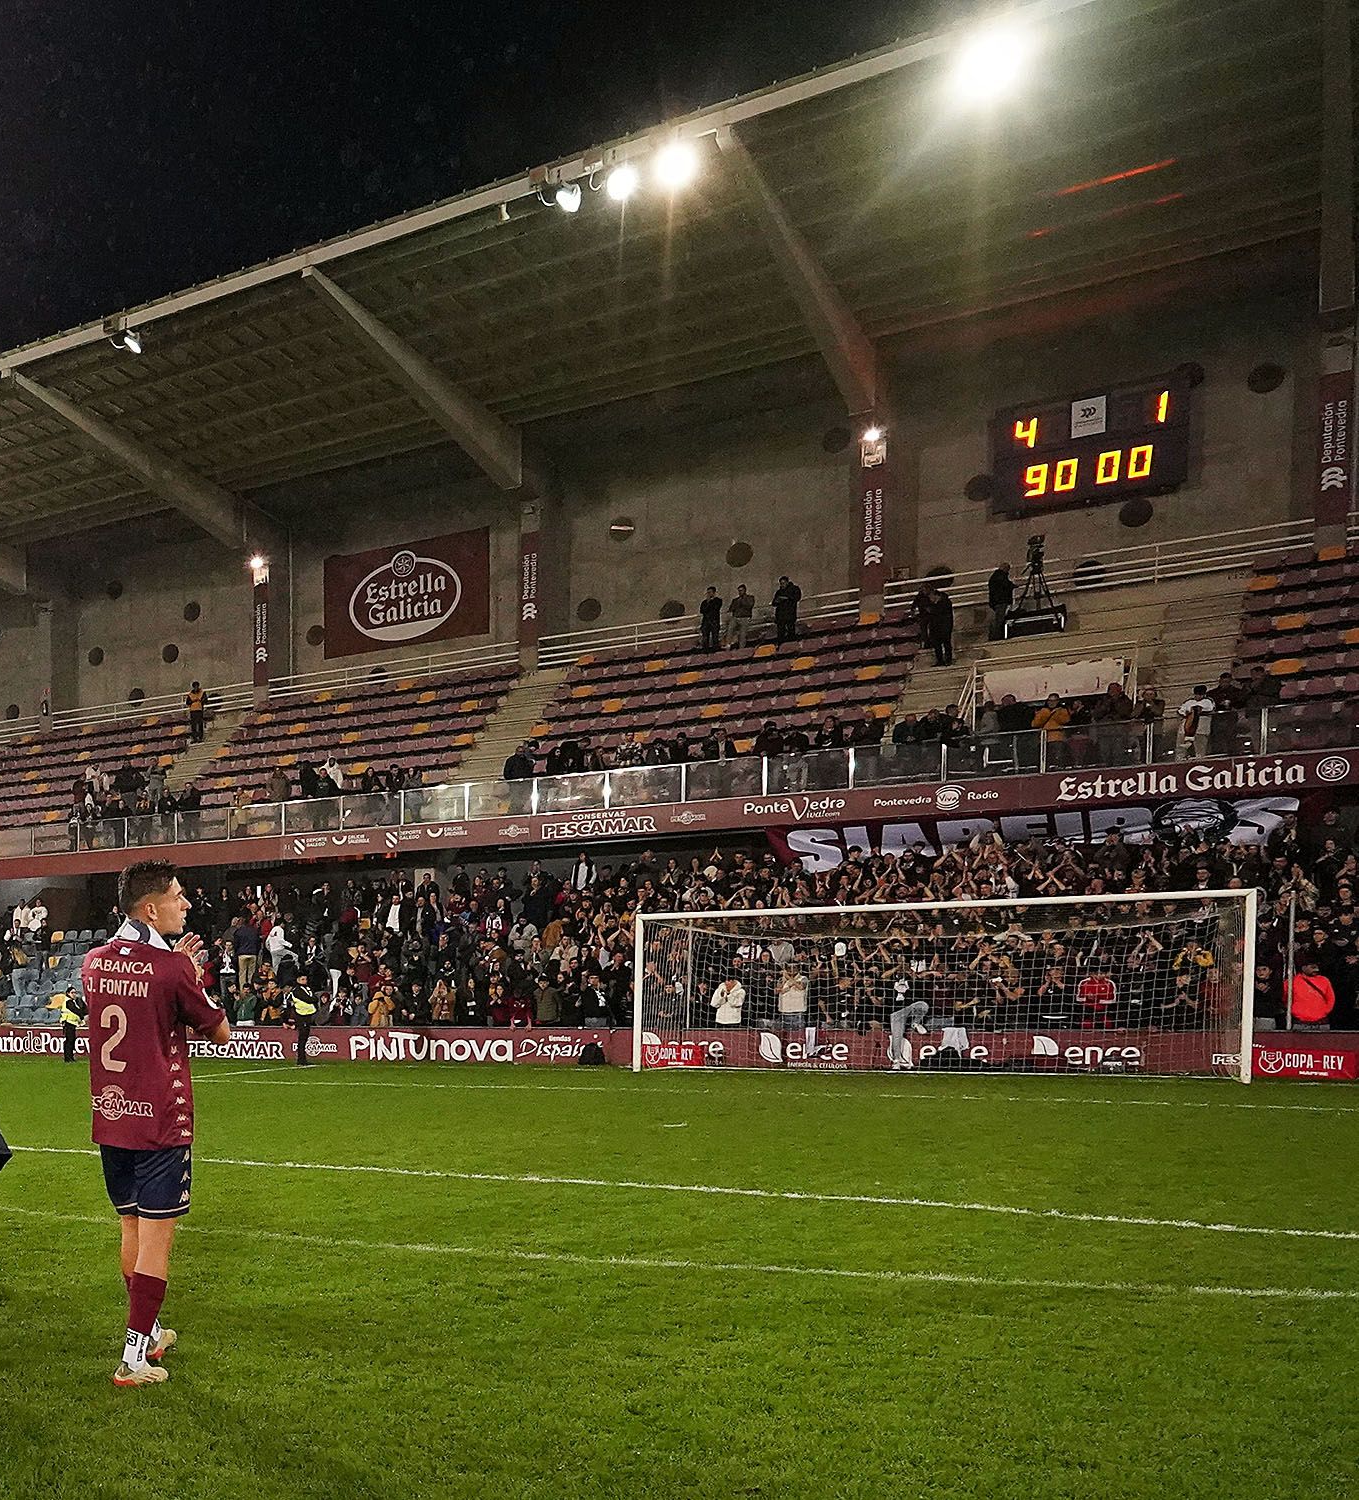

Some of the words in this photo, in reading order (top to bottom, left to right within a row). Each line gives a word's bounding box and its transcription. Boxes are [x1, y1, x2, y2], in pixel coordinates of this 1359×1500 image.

[1015, 417, 1038, 448] 4
[1157, 390, 1169, 423] 1
[1334, 400, 1347, 461] Pontevedra
[1024, 458, 1079, 497] 90
[1096, 444, 1153, 484] 00
[364, 571, 446, 605] Estrella
[368, 594, 442, 625] Galicia
[1055, 771, 1179, 801] Estrella
[1185, 759, 1306, 791] Galicia
[873, 796, 932, 807] Pontevedra
[967, 790, 999, 800] Radio
[542, 816, 657, 840] PESCAMAR
[572, 810, 626, 821] CONSERVAS
[90, 958, 154, 975] ABANCA
[100, 978, 149, 998] FONTAN
[100, 1004, 128, 1073] 2
